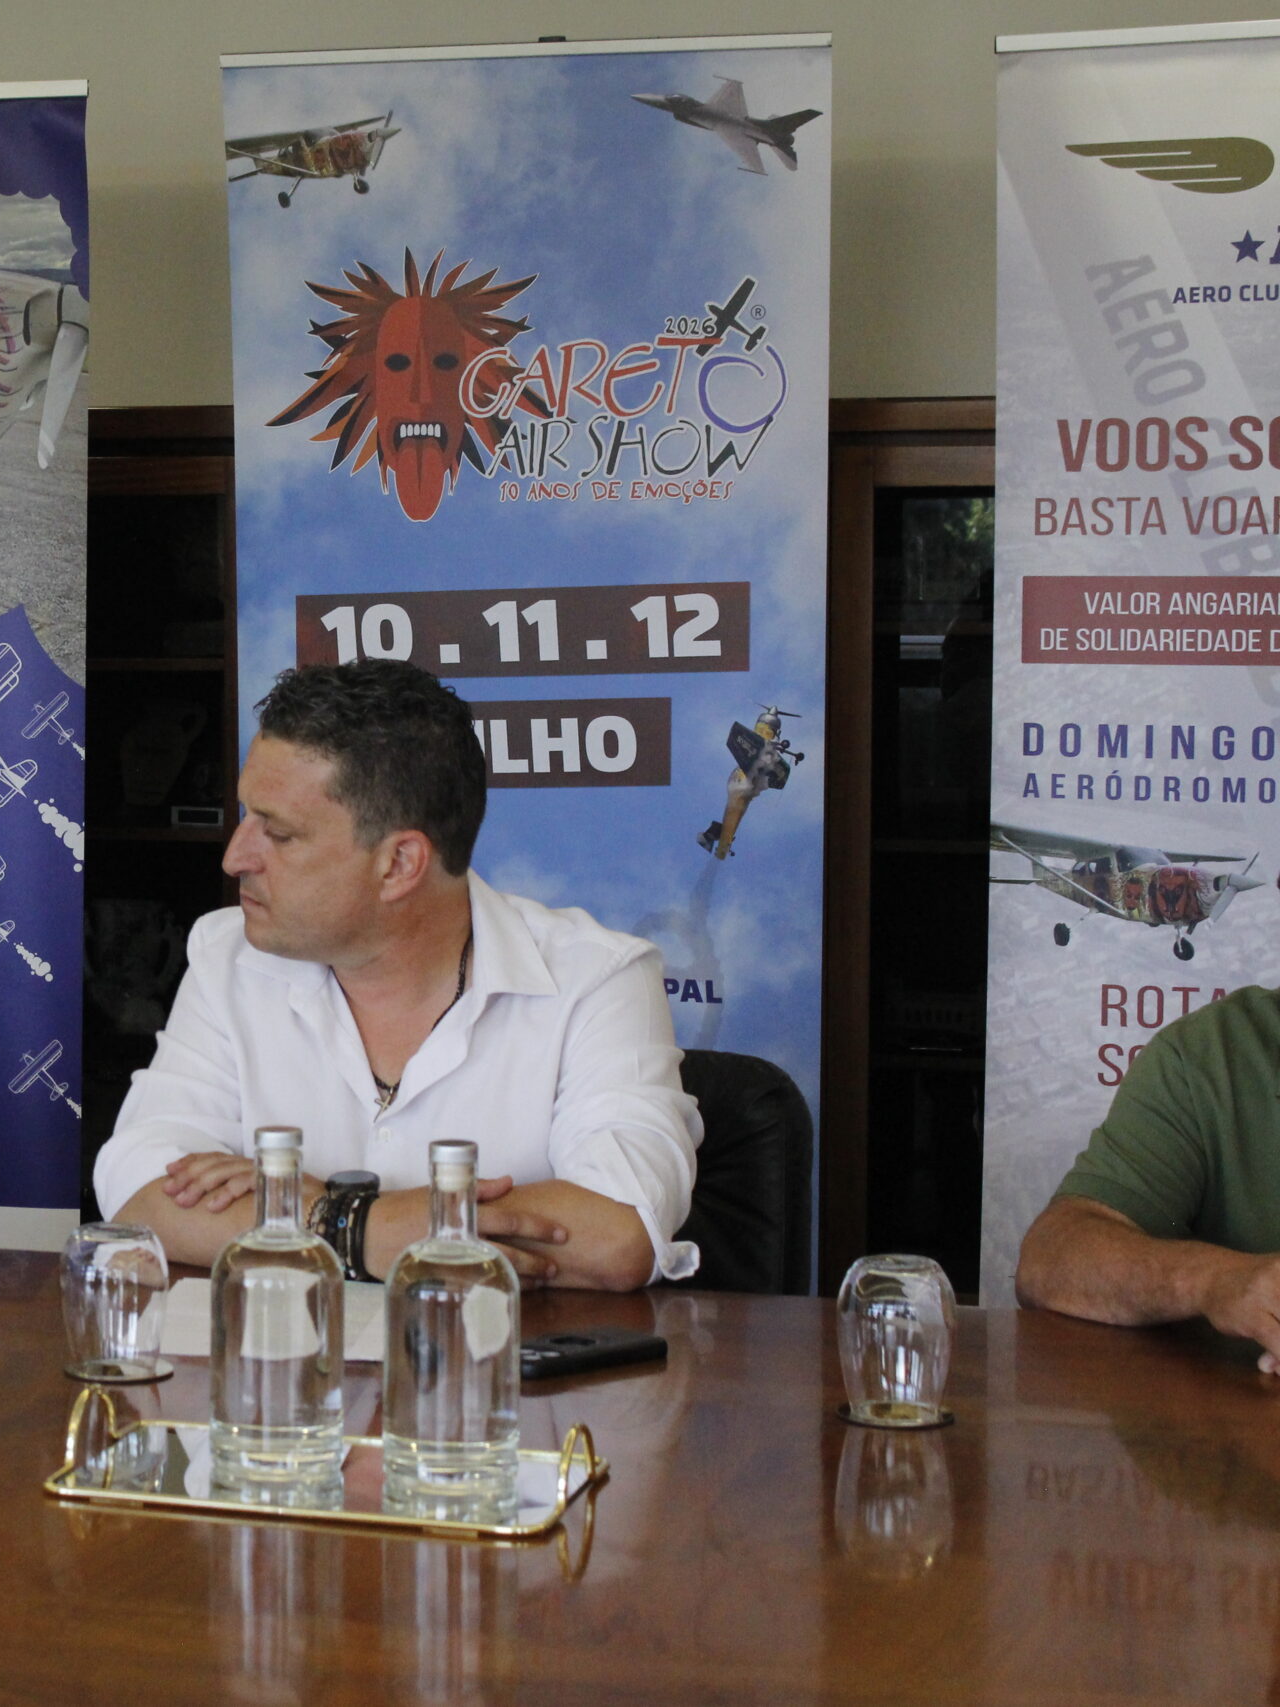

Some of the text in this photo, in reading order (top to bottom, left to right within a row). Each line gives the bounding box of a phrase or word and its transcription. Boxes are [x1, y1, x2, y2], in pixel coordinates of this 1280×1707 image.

[1173, 284, 1280, 304] AERO CLU
[665, 316, 717, 336] 2026
[1084, 254, 1207, 407] AERO
[1057, 416, 1209, 473] VOOS
[501, 480, 733, 503] 10 ANOS DE EMOÇÕES
[1034, 495, 1280, 536] BASTA VOA
[1084, 591, 1280, 616] VALOR ANGARIA
[320, 603, 413, 663] 10
[482, 599, 560, 662] 11
[630, 592, 721, 658] 12
[1040, 627, 1069, 651] DE
[1076, 627, 1262, 653] SOLIDARIEDADE
[472, 715, 637, 774] LHO
[1023, 723, 1275, 761] DOMINGO
[1023, 769, 1276, 804] AERÓDROMO
[1100, 984, 1227, 1029] ROT
